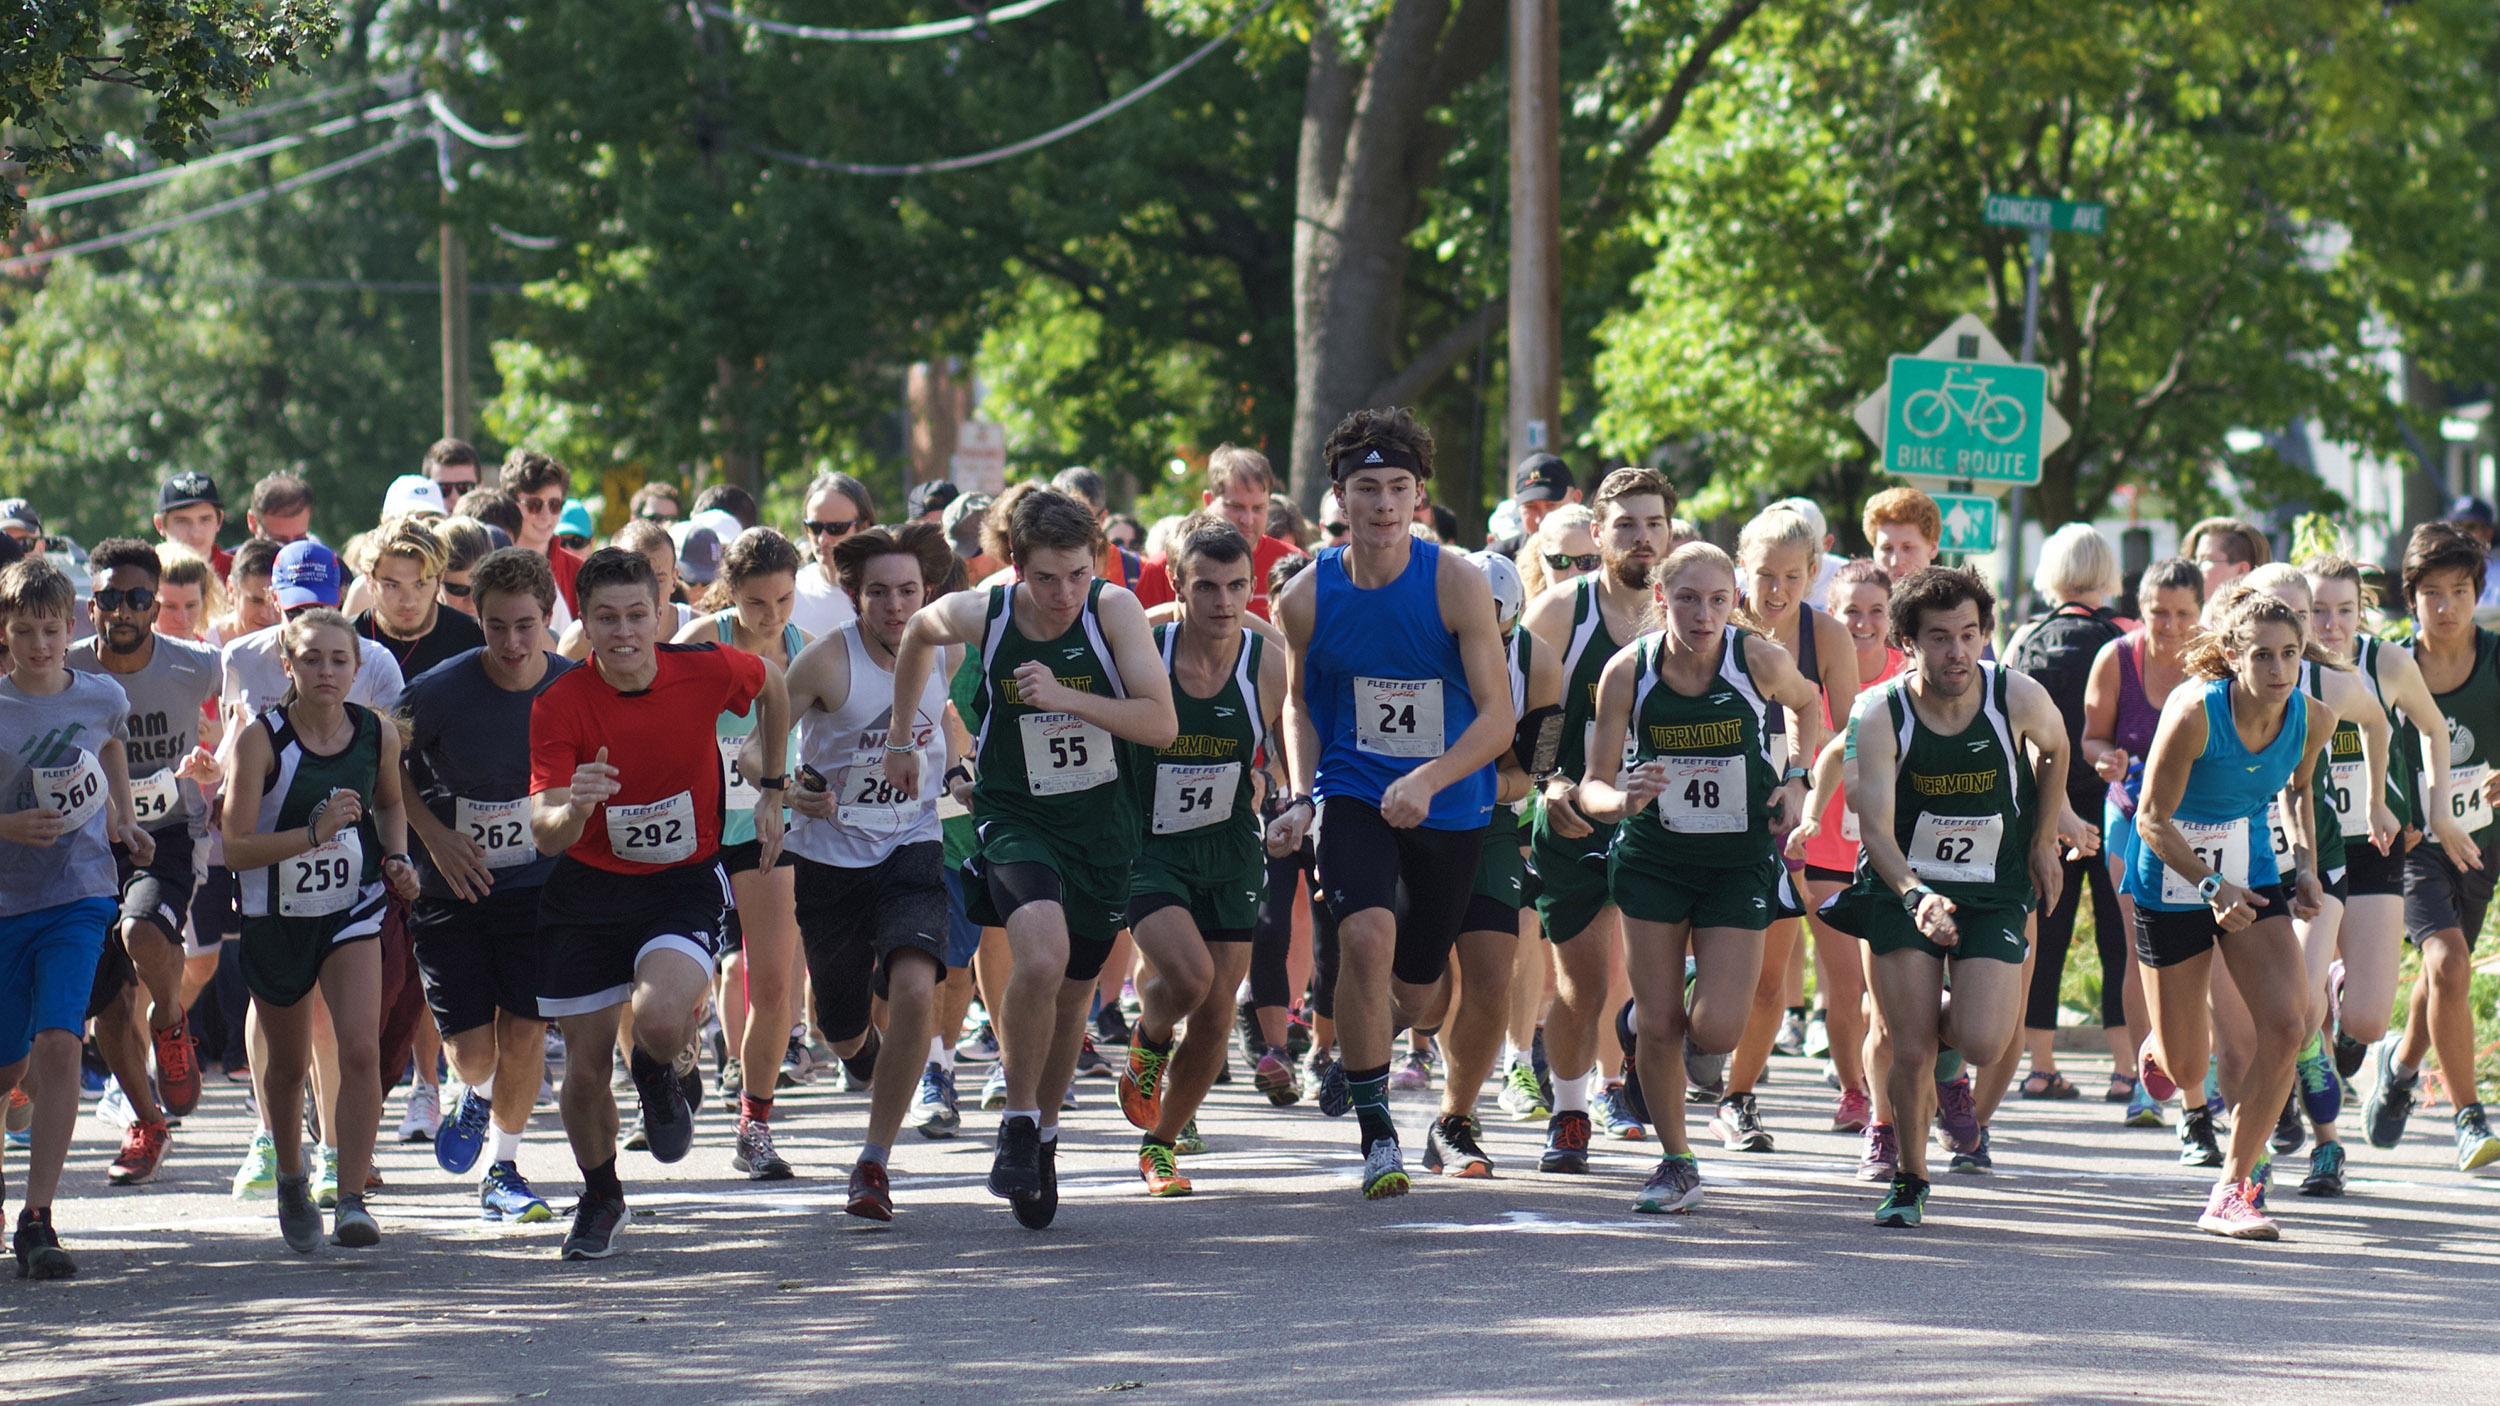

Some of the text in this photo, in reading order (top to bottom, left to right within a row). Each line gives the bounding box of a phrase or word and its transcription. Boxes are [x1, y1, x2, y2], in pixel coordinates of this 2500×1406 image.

[1988, 198, 2103, 230] CONGER AVE
[1897, 444, 2026, 476] BIKE ROUTE
[1367, 680, 1427, 690] FLEET FEET
[128, 711, 168, 737] AM
[1034, 714, 1080, 723] FLEET FE
[1043, 721, 1085, 736] Sports
[1379, 703, 1416, 733] 24
[722, 737, 744, 745] FLEE
[1650, 718, 1741, 750] VERMONT
[127, 732, 186, 763] RLESS
[1049, 736, 1088, 769] 55
[43, 769, 71, 778] FLEET
[1171, 766, 1228, 775] FLEET FEET
[1672, 758, 1731, 767] FLEET FEET
[1678, 765, 1719, 777] Sports
[2336, 765, 2359, 773] FEET
[2459, 768, 2480, 779] FEET
[144, 774, 163, 787] FEET
[1910, 768, 1997, 796] VERMONT
[50, 771, 97, 816] 260
[134, 793, 167, 816] 54
[1179, 787, 1213, 813] 54
[1684, 779, 1720, 808] 48
[2452, 789, 2480, 817] 64
[469, 801, 522, 811] FLEET FEET
[621, 798, 678, 816] FLEET FEET
[626, 819, 682, 848] 292
[1932, 818, 1991, 826] FLEET FEET
[2182, 822, 2238, 831] FLEET FEET
[470, 821, 523, 849] 262
[2187, 831, 2228, 845] Sports
[1936, 837, 1974, 863] 62
[296, 858, 349, 893] 259
